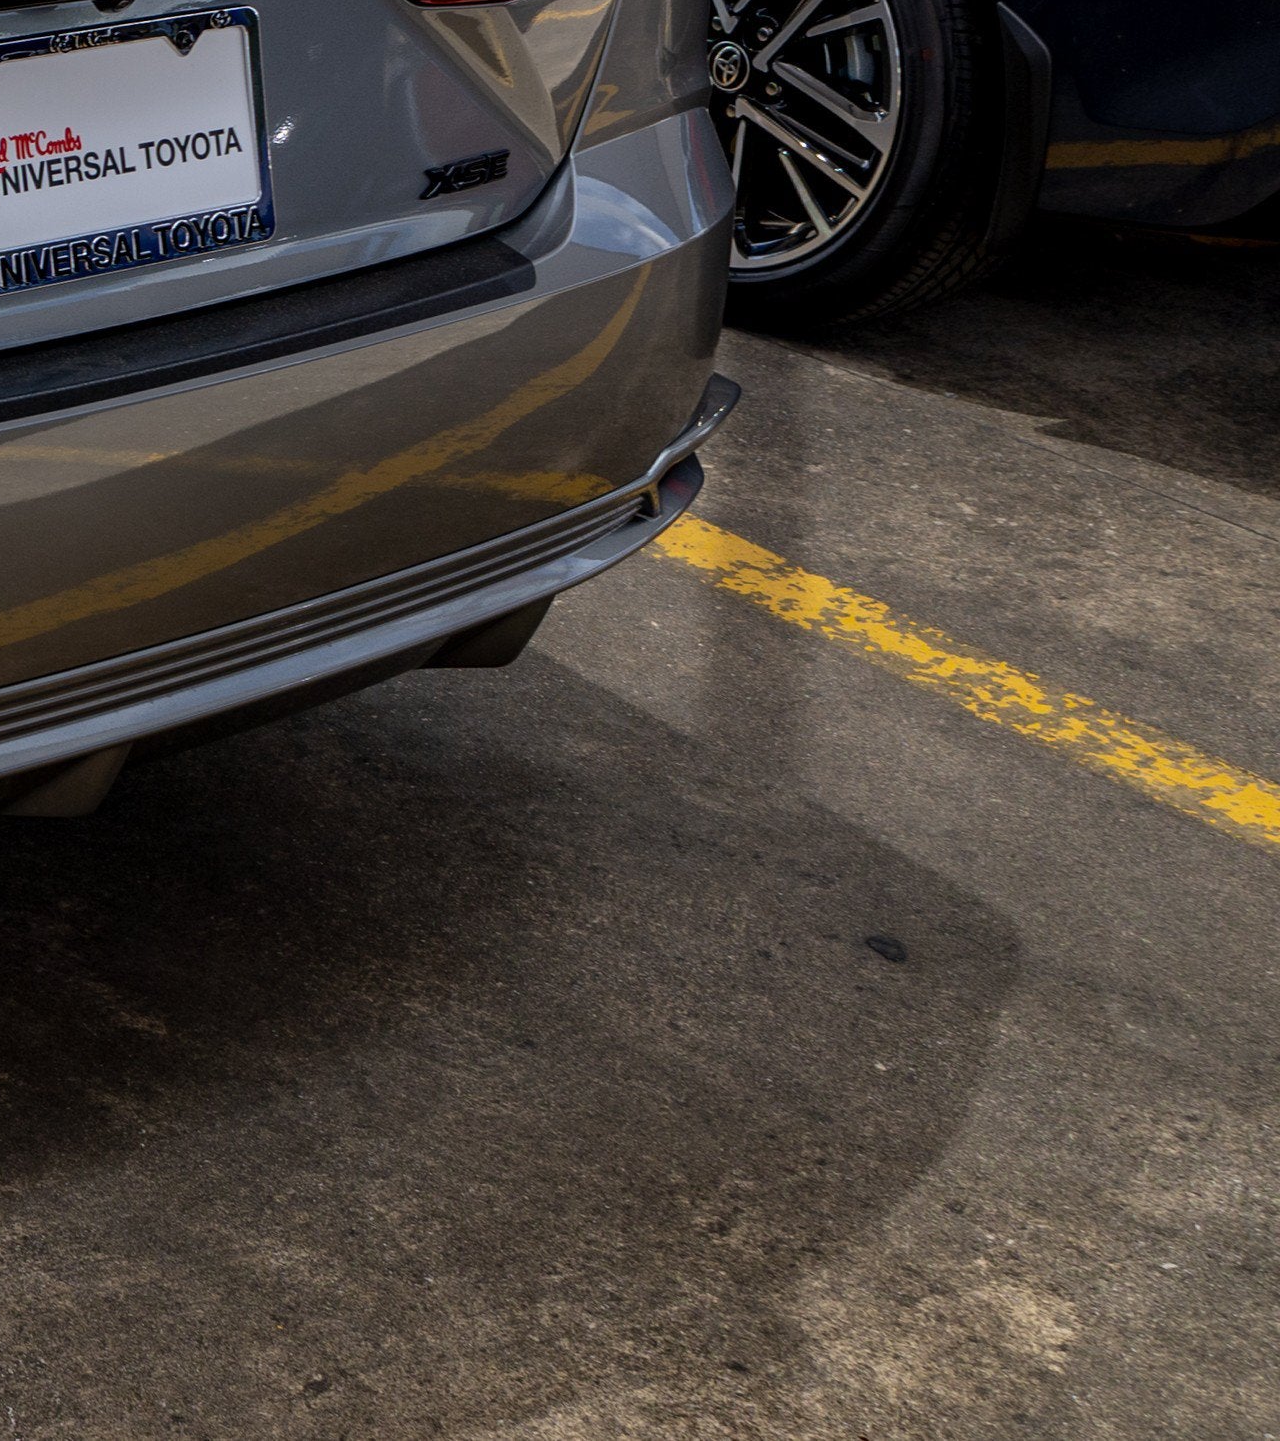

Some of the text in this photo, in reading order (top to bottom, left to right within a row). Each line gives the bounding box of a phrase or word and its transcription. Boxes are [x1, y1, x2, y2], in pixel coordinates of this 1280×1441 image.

[8, 127, 82, 160] McCombs
[138, 127, 243, 169] TOYOTA
[419, 148, 511, 200] XSE
[151, 206, 269, 257] TOYOTA
